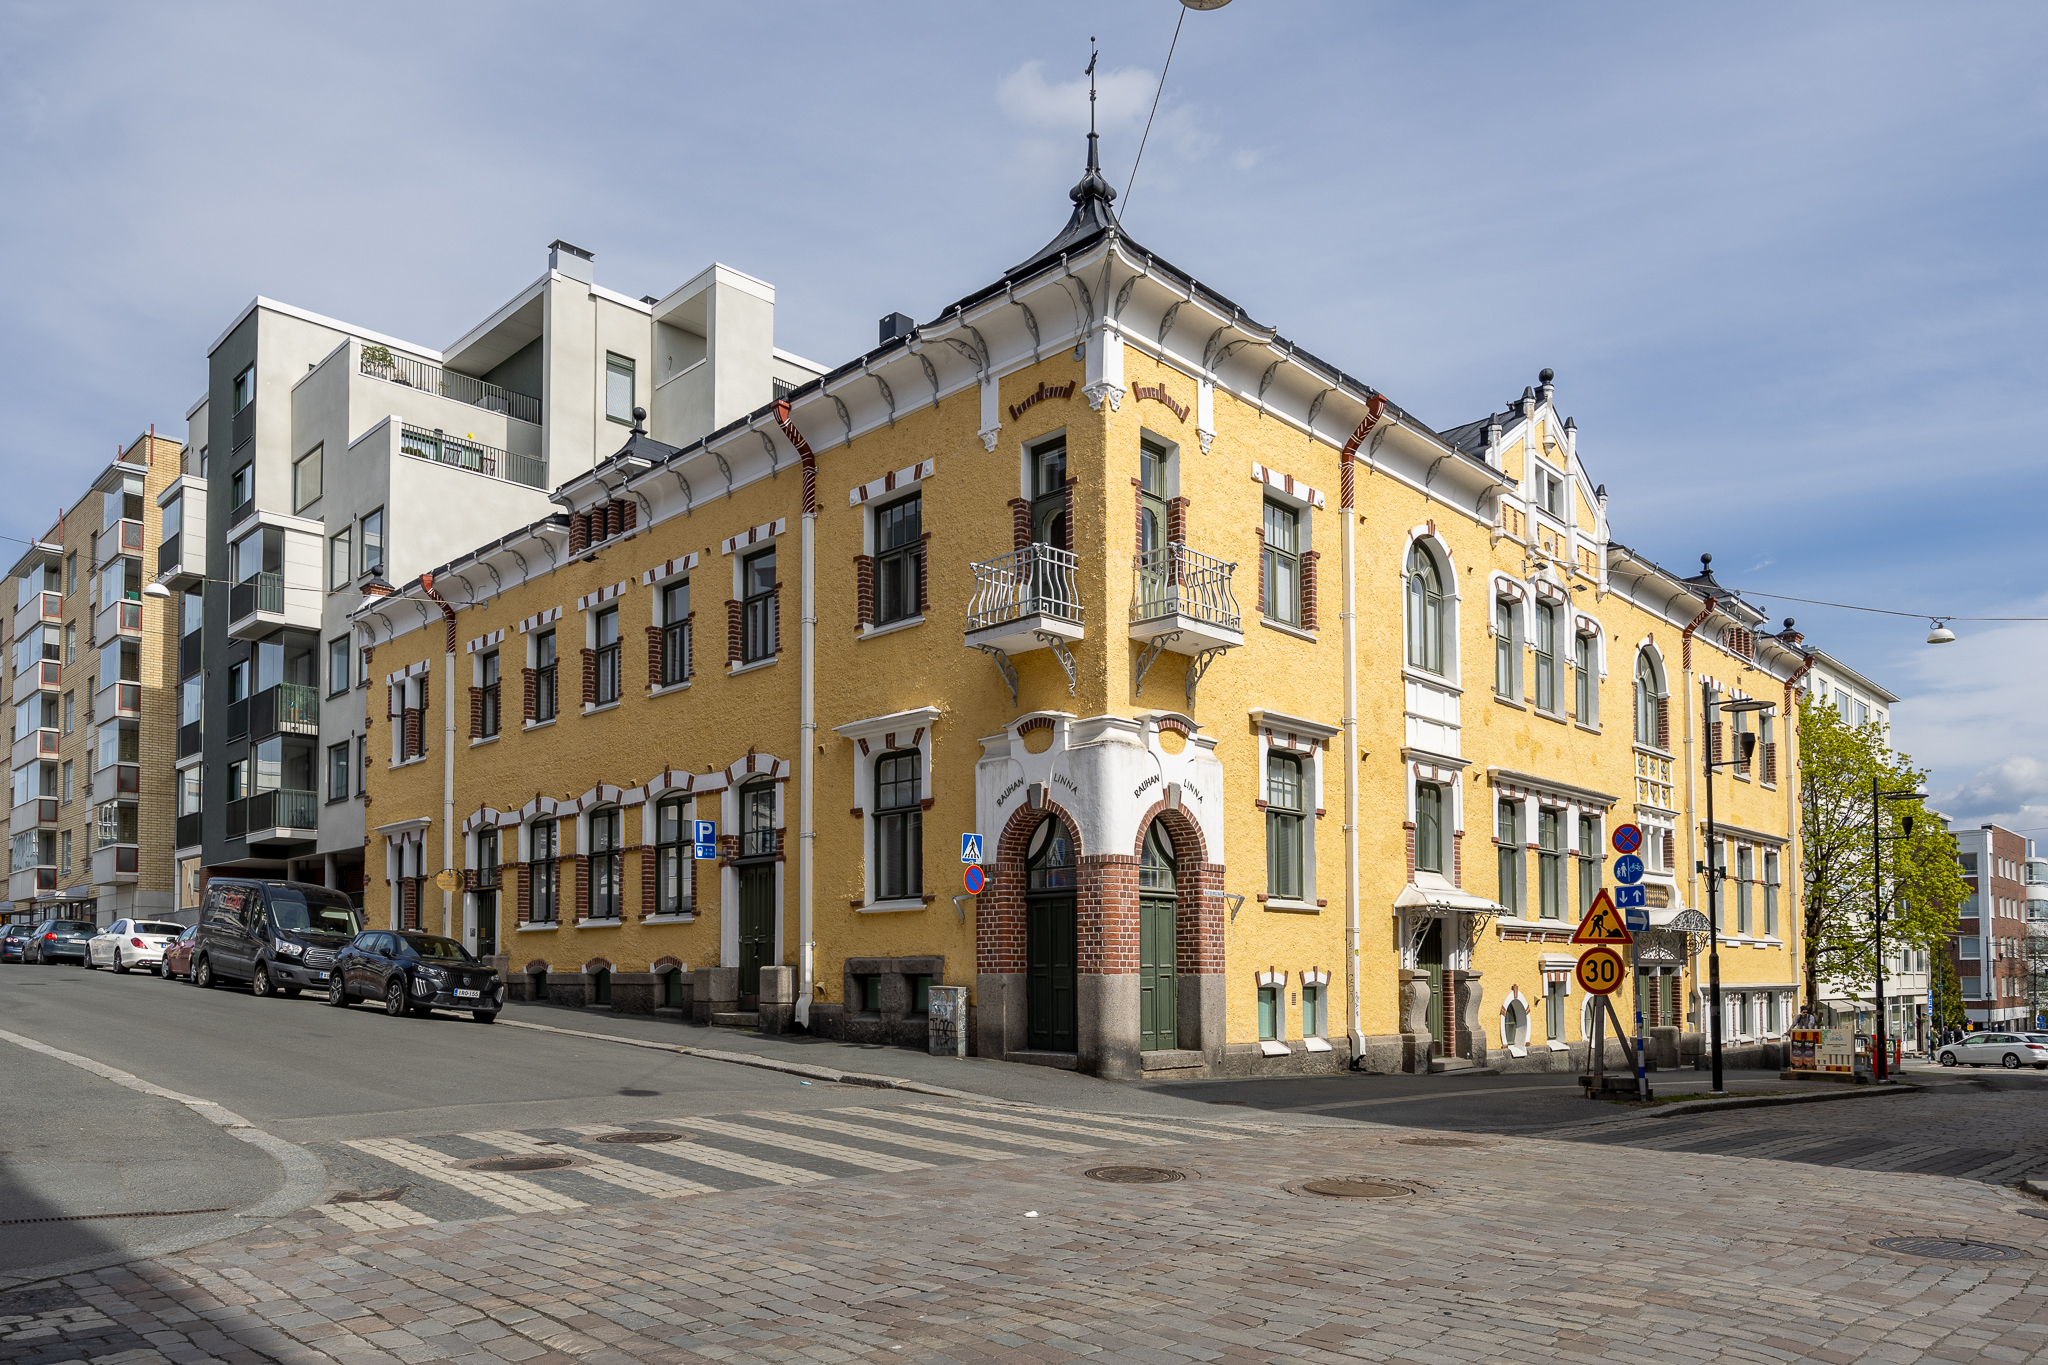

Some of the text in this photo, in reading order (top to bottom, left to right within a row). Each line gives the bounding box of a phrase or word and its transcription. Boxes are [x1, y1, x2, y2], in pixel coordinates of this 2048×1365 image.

[996, 773, 1078, 807] RAUHAN LINNA
[1133, 773, 1204, 804] RAUHAN LINNA
[699, 822, 713, 842] P
[1585, 959, 1614, 983] 30
